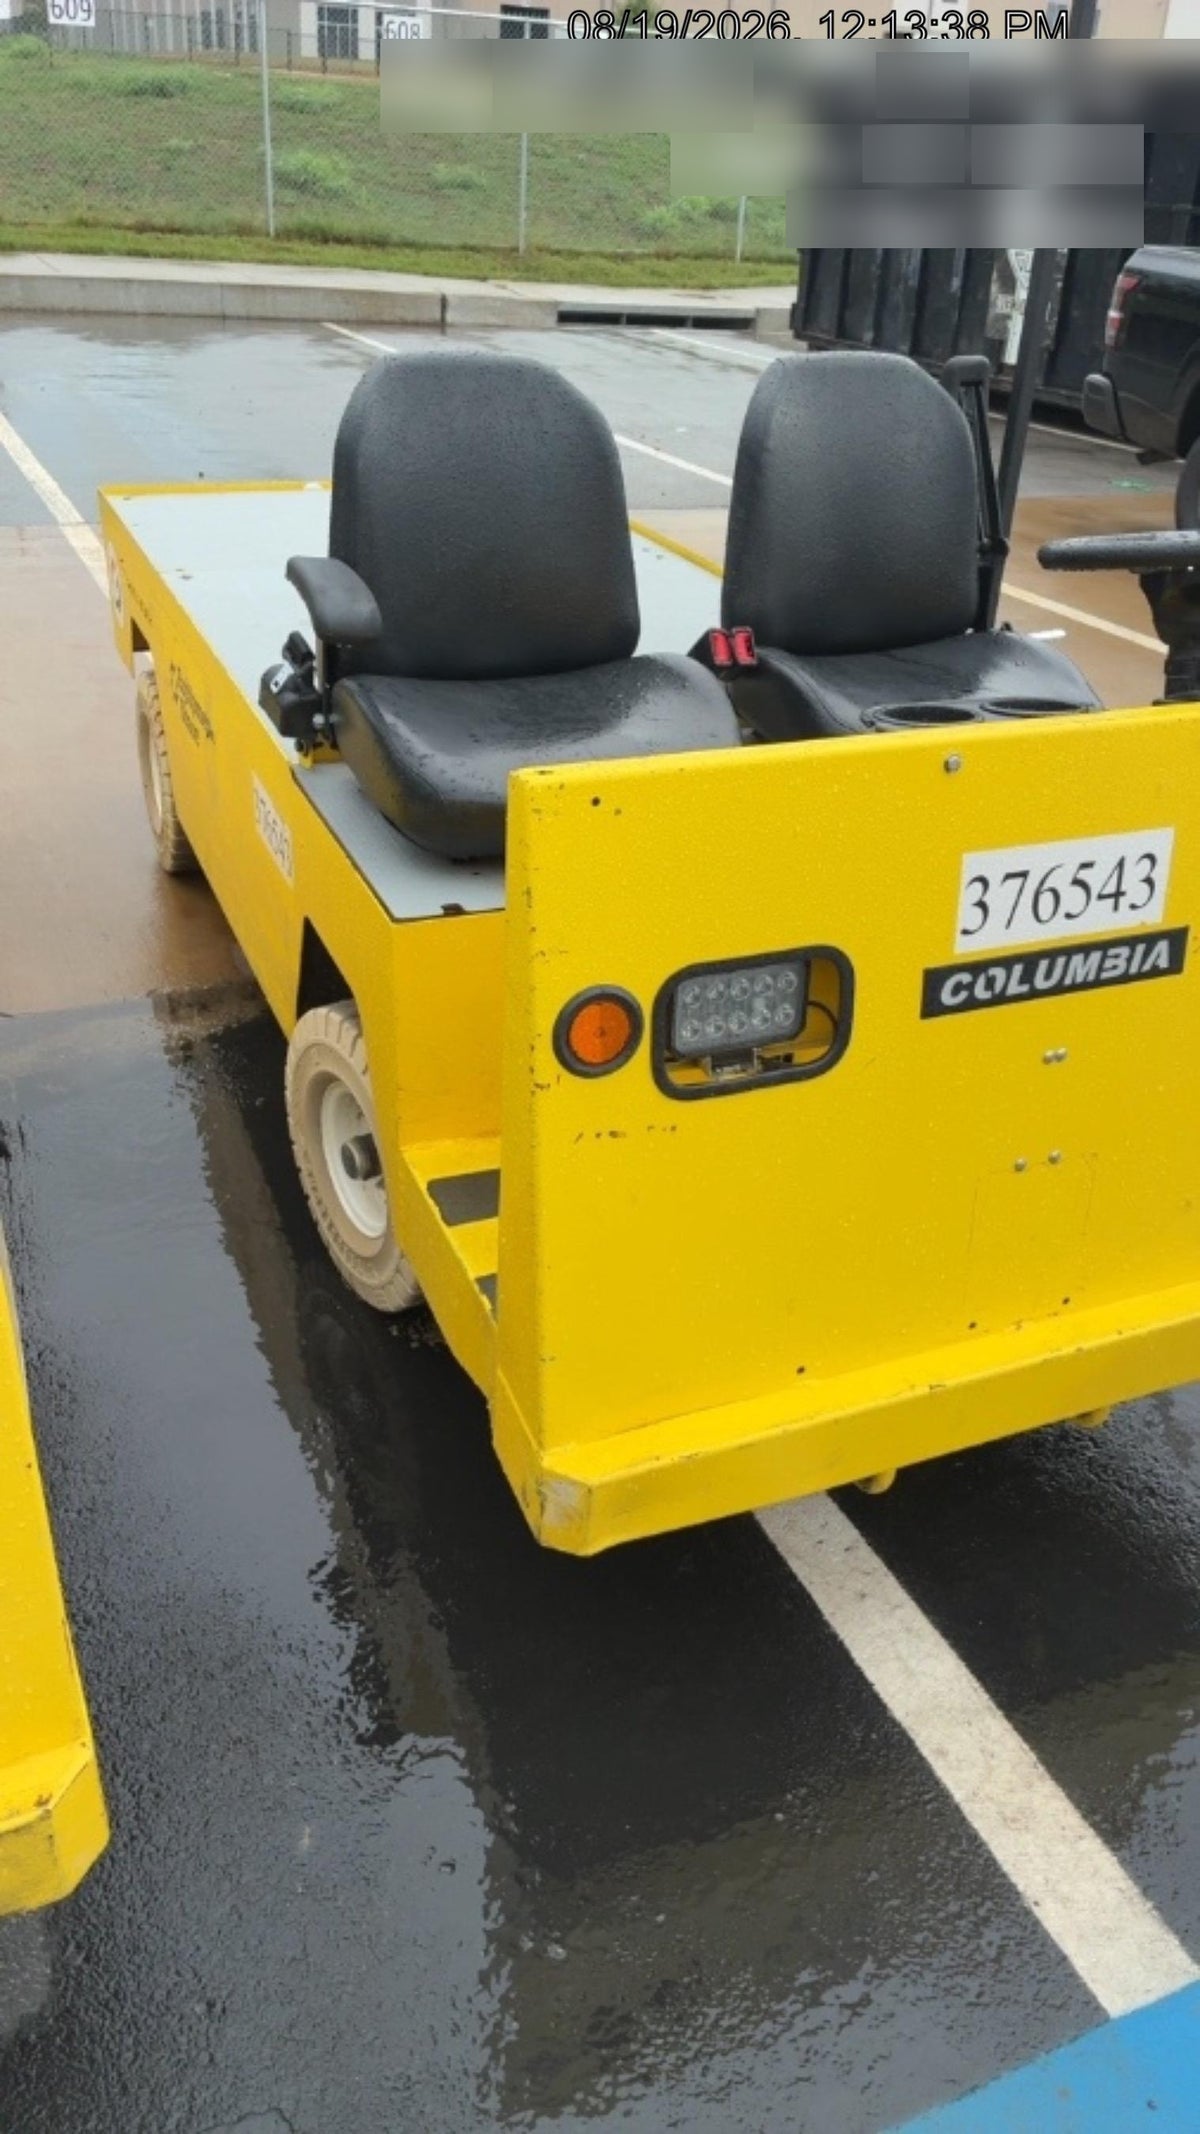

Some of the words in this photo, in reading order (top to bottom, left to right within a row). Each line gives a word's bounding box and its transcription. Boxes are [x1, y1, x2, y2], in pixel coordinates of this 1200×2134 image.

[52, 0, 91, 21] 609
[385, 20, 420, 39] 608
[960, 852, 1157, 935] 376543
[940, 938, 1170, 1007] COLUMBIA
